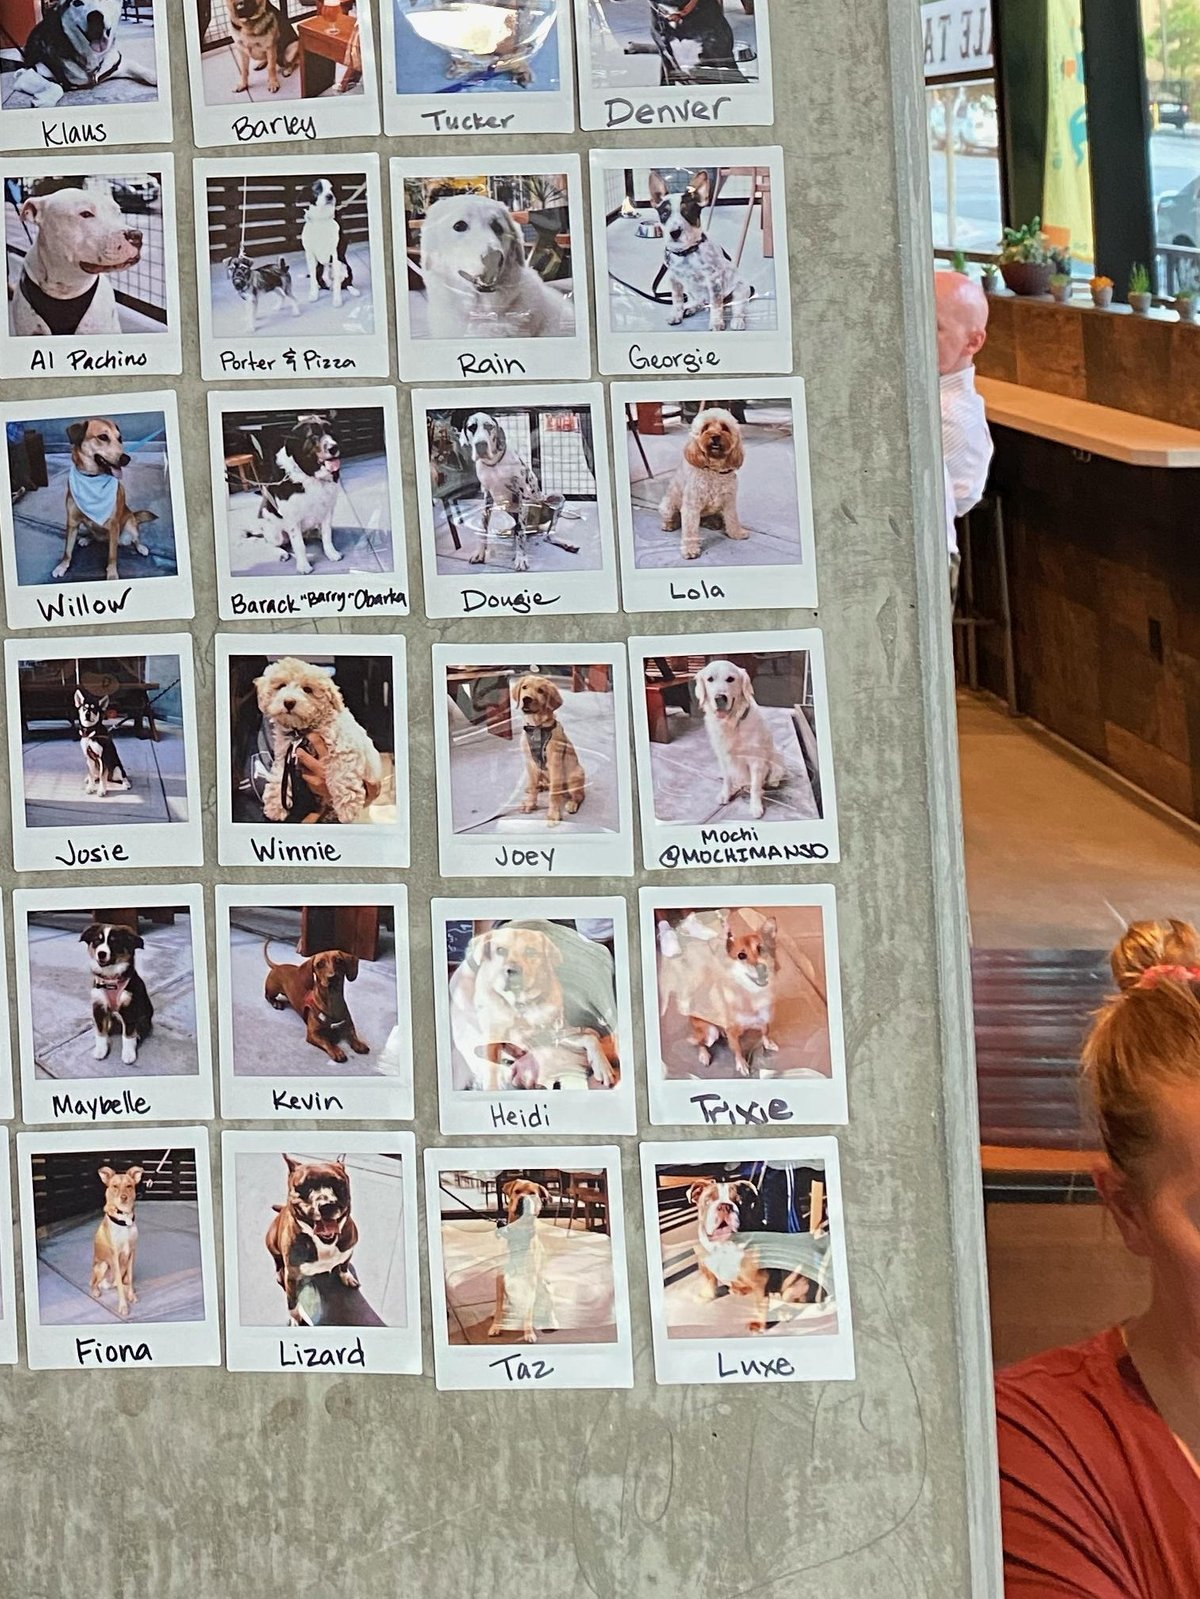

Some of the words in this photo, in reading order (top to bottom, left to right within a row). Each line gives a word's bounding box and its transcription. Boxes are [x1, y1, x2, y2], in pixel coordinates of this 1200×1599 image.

[420, 109, 516, 132] Tucker
[603, 96, 734, 128] Denver
[41, 120, 111, 149] Klaus
[231, 115, 321, 142] Barley
[66, 349, 148, 371] Pachino
[219, 350, 277, 372] Porter
[281, 347, 297, 373] &
[302, 349, 357, 371] Pizza
[456, 352, 526, 377] Rain
[628, 344, 721, 373] Georgie
[460, 588, 562, 613] Dougie
[669, 579, 726, 601] Lola
[36, 586, 133, 623] Willow
[230, 593, 300, 615] Barack
[700, 826, 759, 846] Mochi
[54, 839, 130, 867] Josie
[250, 836, 342, 863] Winnie
[494, 845, 555, 871] Joey
[51, 1090, 152, 1121] Maybelle
[272, 1088, 344, 1111] Kevin
[689, 1093, 794, 1123] Trixie
[490, 1102, 550, 1128] Heidi
[75, 1337, 153, 1365] Fiona
[279, 1336, 366, 1368] Lizard
[489, 1353, 555, 1382] Taz
[717, 1352, 795, 1378] Luxe
